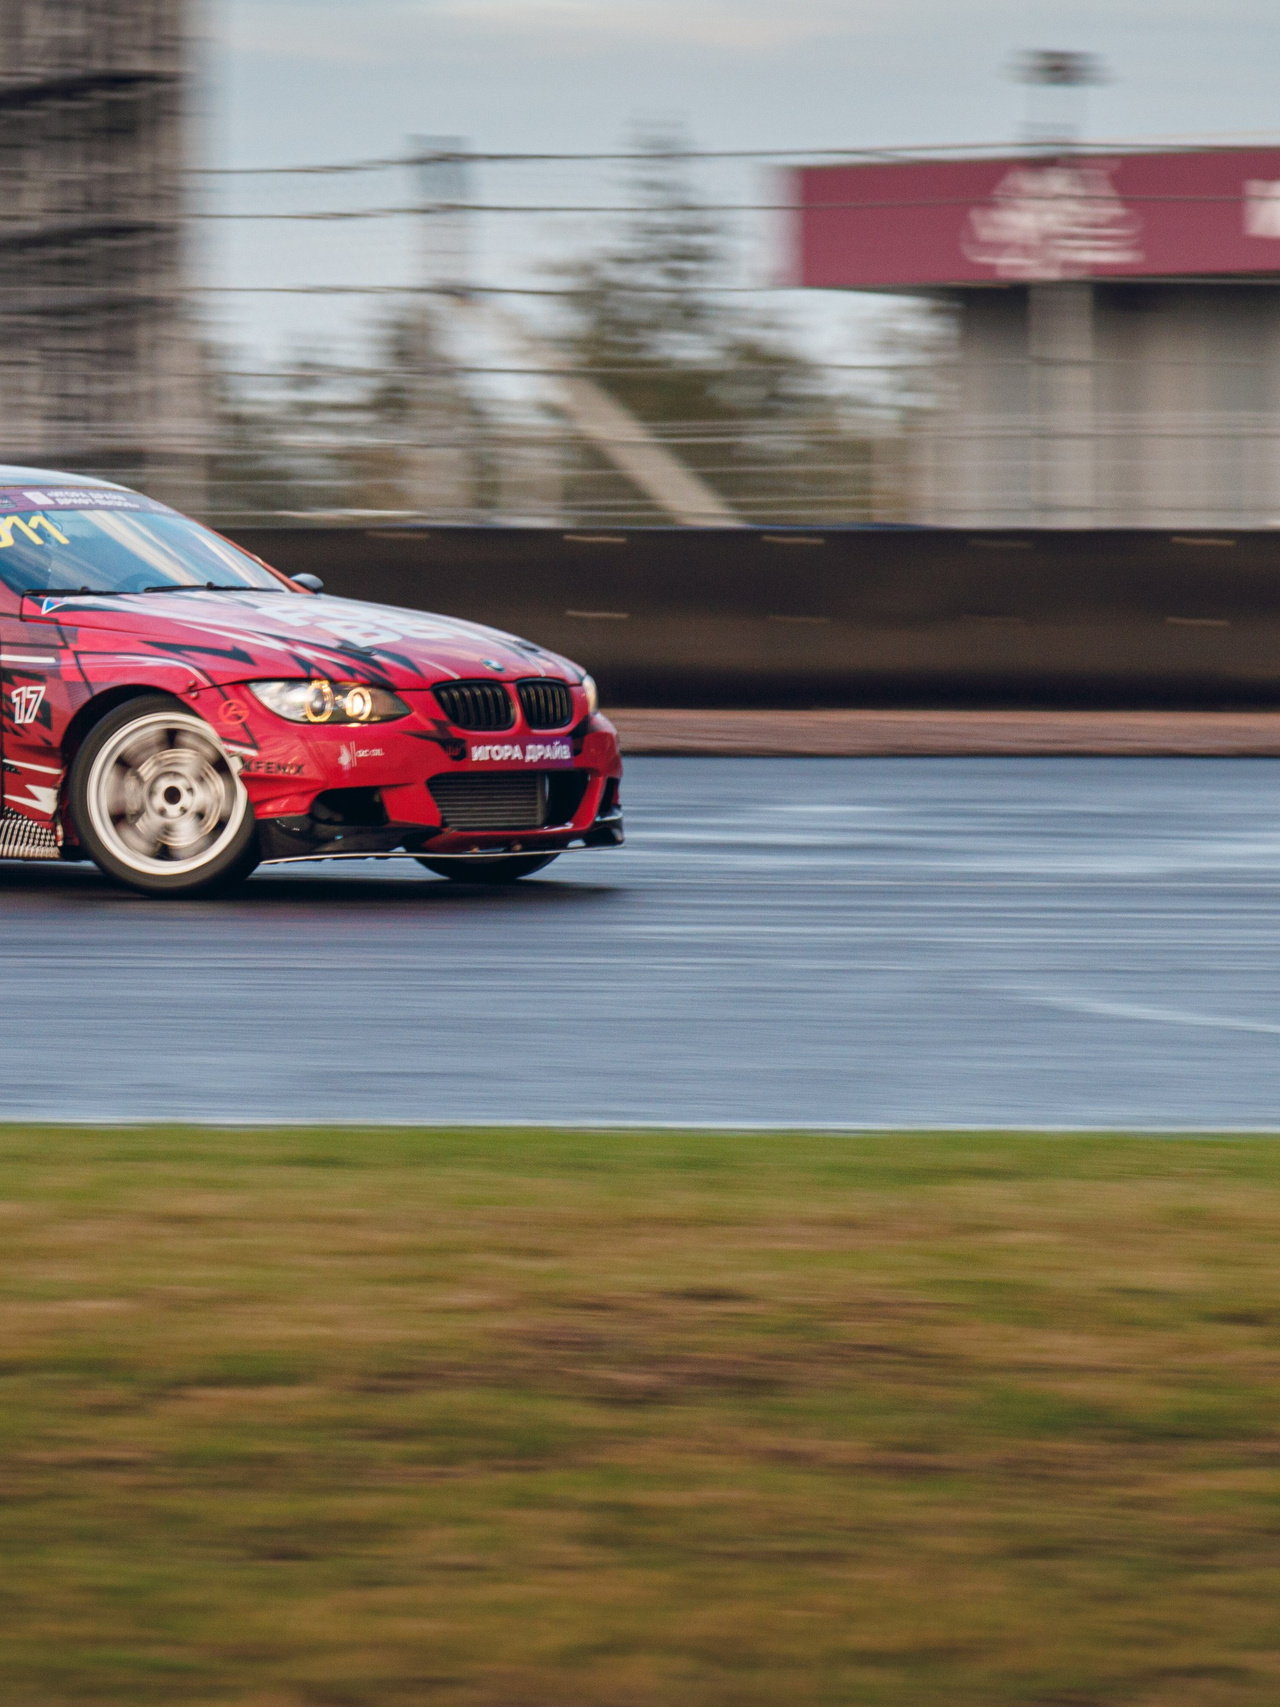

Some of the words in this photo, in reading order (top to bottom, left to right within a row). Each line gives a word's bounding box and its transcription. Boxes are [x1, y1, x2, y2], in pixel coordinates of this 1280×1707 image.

[11, 683, 47, 725] 17
[471, 744, 523, 761] ИГОРА
[525, 740, 571, 763] ДРАЙВ
